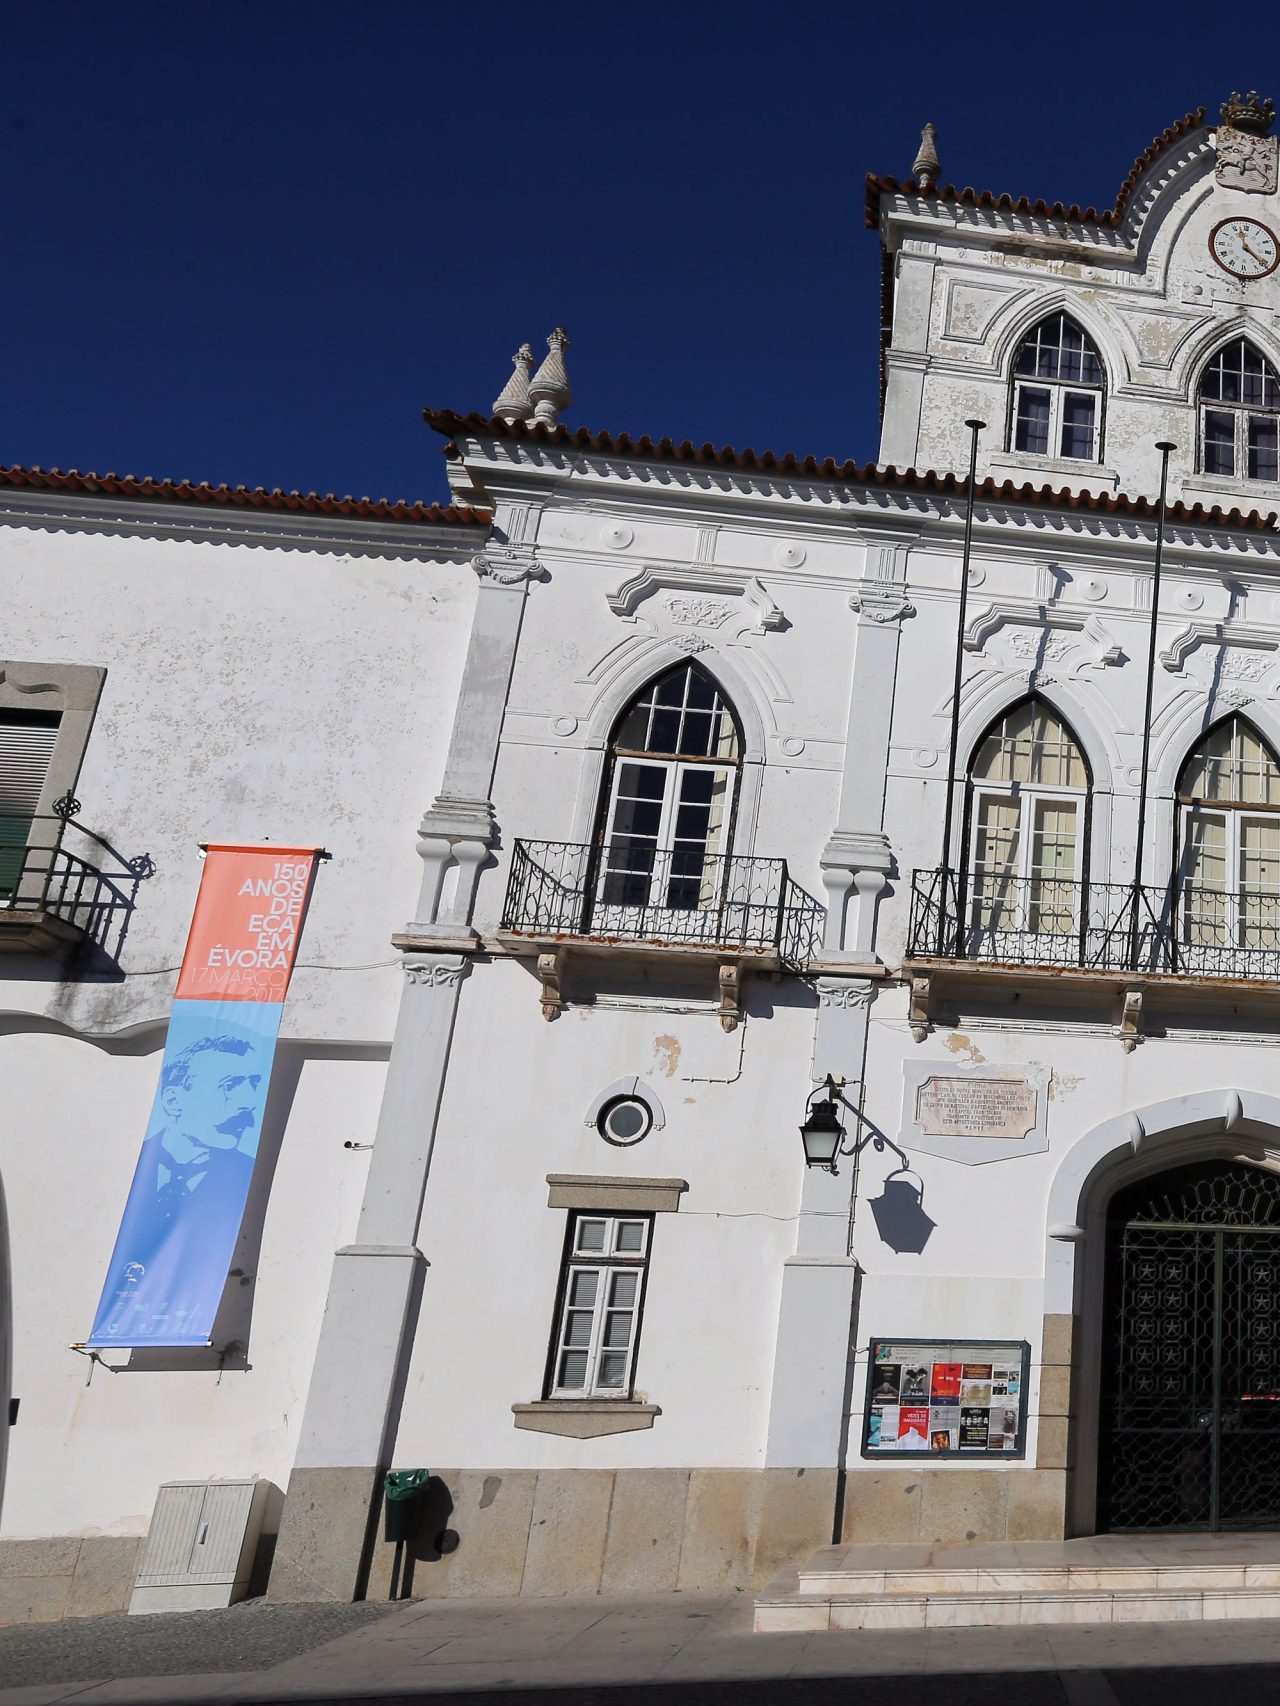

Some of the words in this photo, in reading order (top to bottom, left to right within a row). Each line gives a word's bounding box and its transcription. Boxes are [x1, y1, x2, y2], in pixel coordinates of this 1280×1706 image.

[273, 863, 308, 880] 150
[238, 879, 305, 897] ANOS
[271, 898, 302, 915] DE
[248, 914, 295, 935] EÇA
[257, 934, 294, 951] EM
[207, 944, 288, 968] ÉVORA
[243, 987, 284, 1002] 2017
